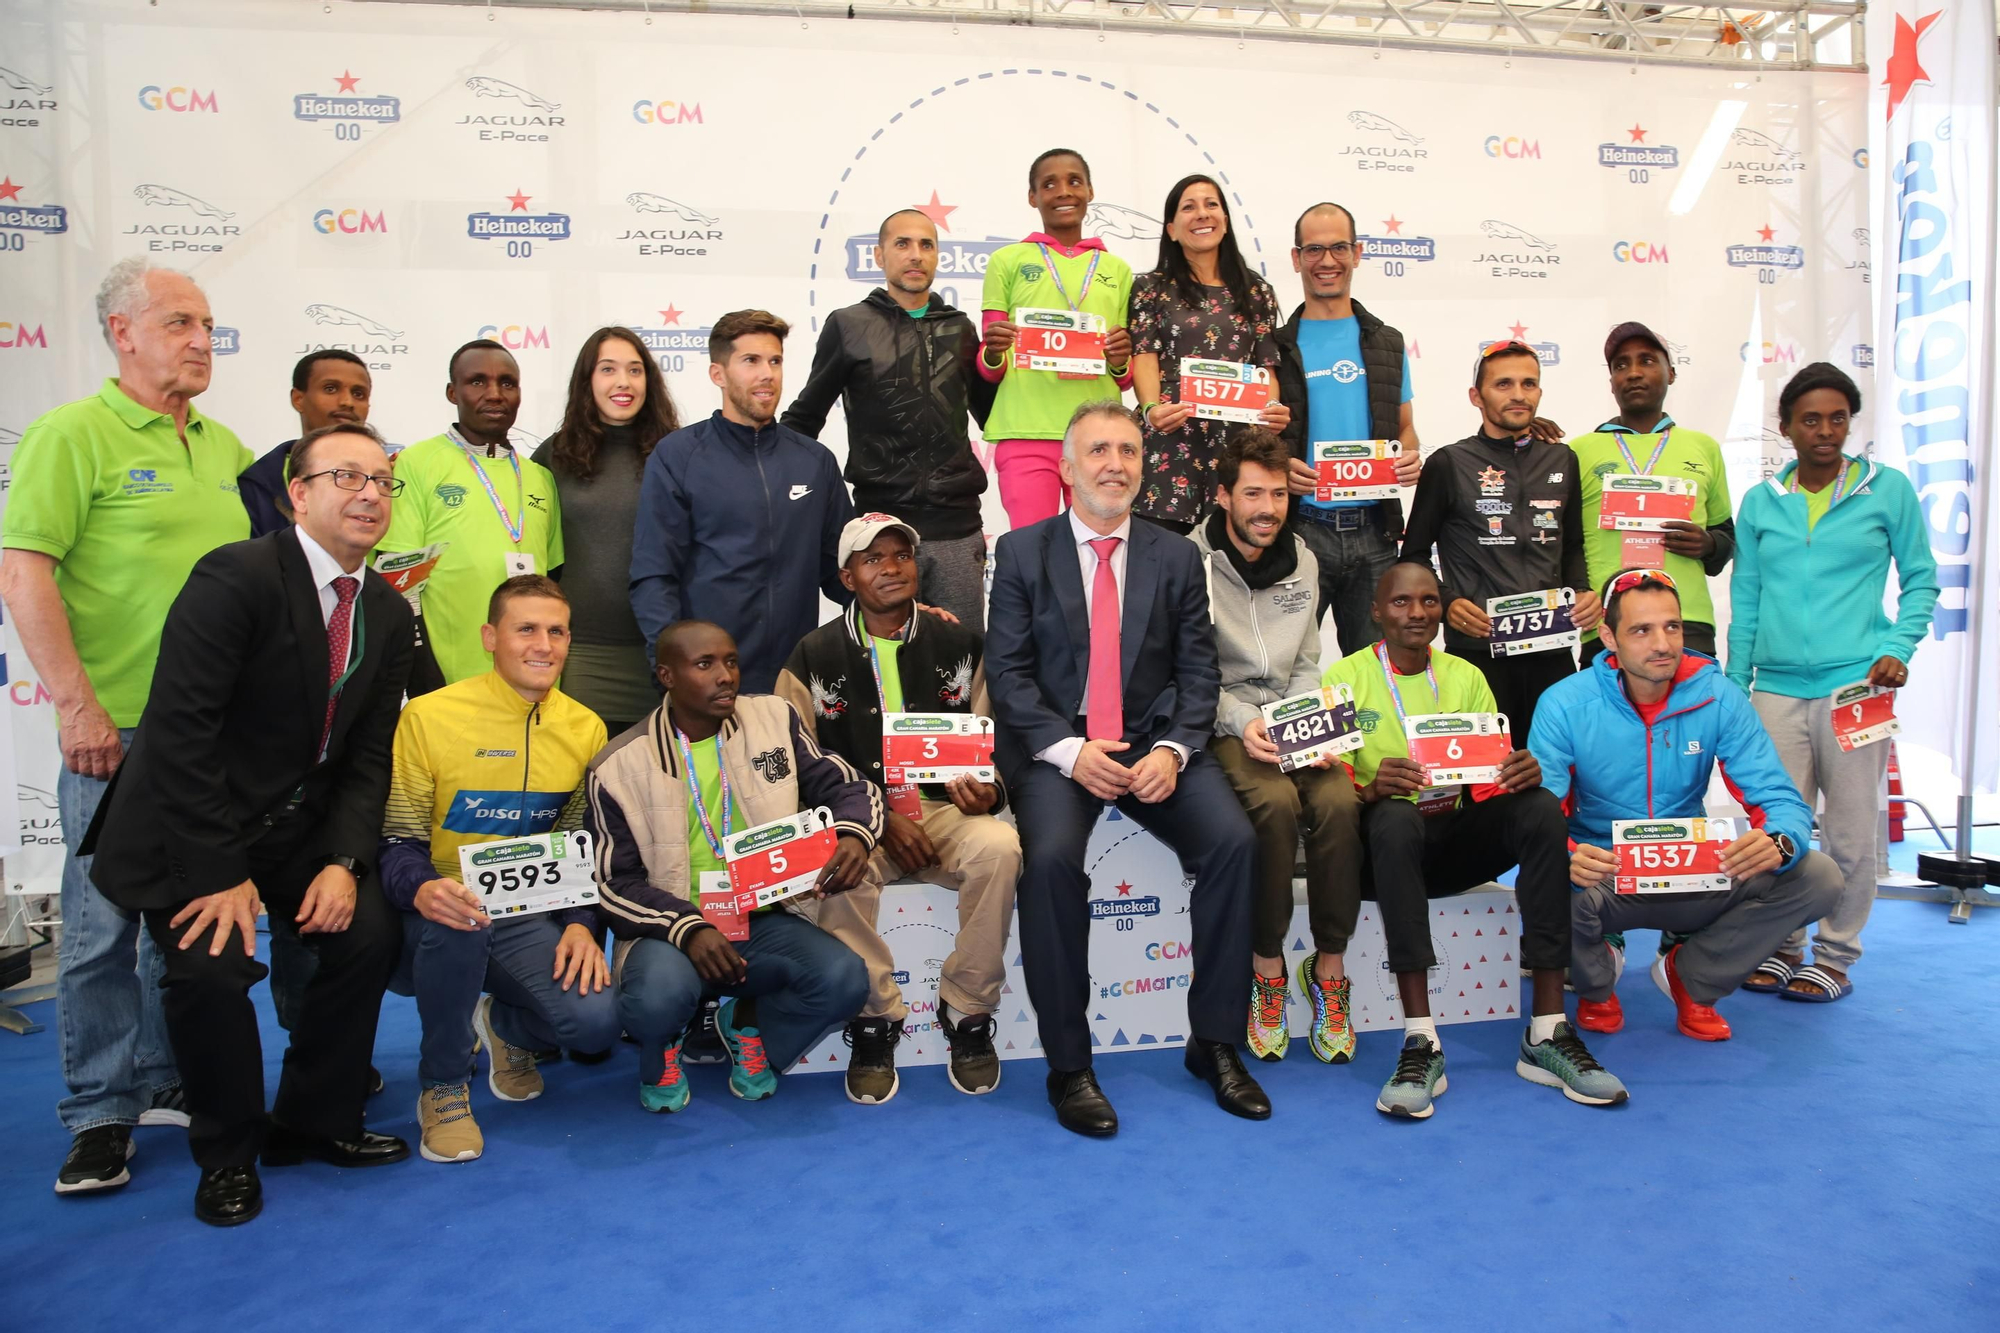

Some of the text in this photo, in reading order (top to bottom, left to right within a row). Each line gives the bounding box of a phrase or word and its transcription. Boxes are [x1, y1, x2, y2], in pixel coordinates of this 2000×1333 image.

[139, 86, 218, 113] GCM
[300, 97, 395, 118] Heineken
[632, 100, 703, 124] GCM
[0, 117, 39, 127] ace
[455, 115, 565, 127] JAGUAR
[335, 124, 361, 141] 0.0
[479, 130, 549, 142] E-Pace
[1338, 146, 1428, 159] JAGUAR
[1484, 135, 1541, 159] GCM
[1602, 148, 1675, 165] Heineken
[1357, 160, 1415, 172] E-Pace
[1721, 162, 1806, 171] JAGUAR
[1629, 169, 1649, 184] 0.0
[1738, 174, 1794, 185] E-Pace
[0, 208, 62, 228] eken
[314, 209, 387, 234] GCM
[122, 225, 240, 236] JAGUAR
[473, 216, 566, 235] Heineken
[616, 230, 723, 241] JAGUAR
[149, 240, 223, 252] E-Pace
[507, 240, 532, 258] 0.0
[639, 244, 707, 256] E-Pace
[1613, 241, 1669, 263] GCM
[1472, 253, 1561, 265] JAGUAR
[1731, 249, 1800, 266] Heineken
[1384, 261, 1404, 277] 0.0
[1491, 267, 1547, 278] E-Pace
[1758, 268, 1775, 284] 0.0
[0, 321, 48, 349] CM
[640, 334, 710, 348] eineke
[1041, 331, 1067, 351] 10
[660, 355, 684, 373] 0.0
[1244, 373, 1251, 381] 2
[1192, 378, 1245, 401] 1577
[1377, 449, 1383, 457] 1
[1332, 461, 1372, 480] 100
[447, 495, 461, 506] 42
[1635, 494, 1646, 511] 1
[394, 570, 411, 587] 4
[1273, 590, 1312, 605] SALMING
[1497, 610, 1555, 635] 4737
[10, 680, 54, 706] CM
[1326, 697, 1333, 705] 1
[1852, 703, 1863, 723] 9
[912, 718, 942, 726] cajasiete
[961, 724, 968, 732] E
[1282, 711, 1335, 744] 4821
[1362, 721, 1374, 731] 42
[1481, 724, 1487, 732] E
[922, 737, 939, 759] 3
[1446, 738, 1463, 760] 6
[1419, 800, 1454, 811] ATHLETE
[530, 808, 558, 820] HPS
[753, 827, 783, 841] cajasiete
[804, 824, 810, 834] E
[1643, 825, 1675, 834] cajasiete
[1696, 829, 1702, 839] 1
[21, 834, 67, 846] Pace
[495, 844, 530, 856] cajasiete
[554, 844, 563, 855] 3
[1629, 844, 1698, 868] 1537
[768, 848, 788, 874] 5
[478, 861, 561, 895] 9593
[749, 881, 765, 890] EVANS
[704, 901, 736, 910] ATHLE
[1092, 900, 1157, 916] Heineken
[1116, 918, 1134, 931] 0.0
[1145, 941, 1193, 960] GCM
[1101, 970, 1194, 999] #GCMara
[903, 1001, 935, 1013] CM
